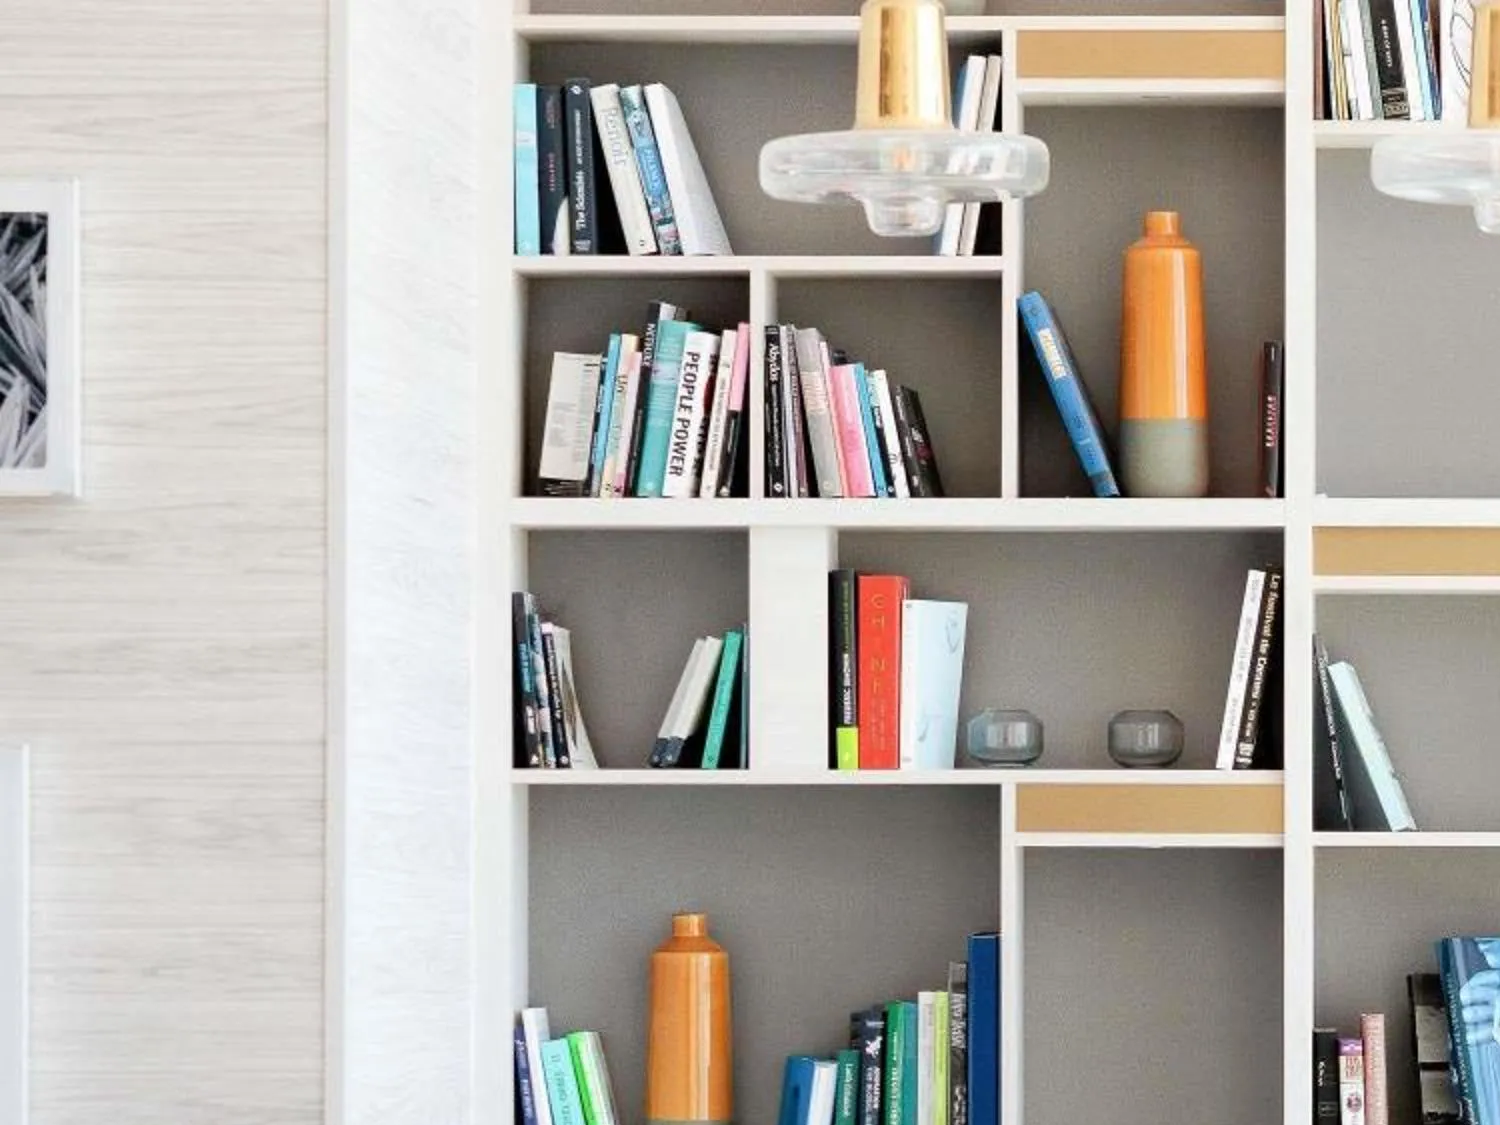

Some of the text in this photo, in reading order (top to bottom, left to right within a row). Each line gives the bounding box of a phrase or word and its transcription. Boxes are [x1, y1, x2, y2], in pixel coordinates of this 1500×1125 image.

[768, 342, 781, 382] Abydos
[669, 351, 700, 477] PEOPLE POWER
[1268, 574, 1281, 589] Le
[1261, 591, 1279, 638] festival
[1258, 639, 1271, 655] de
